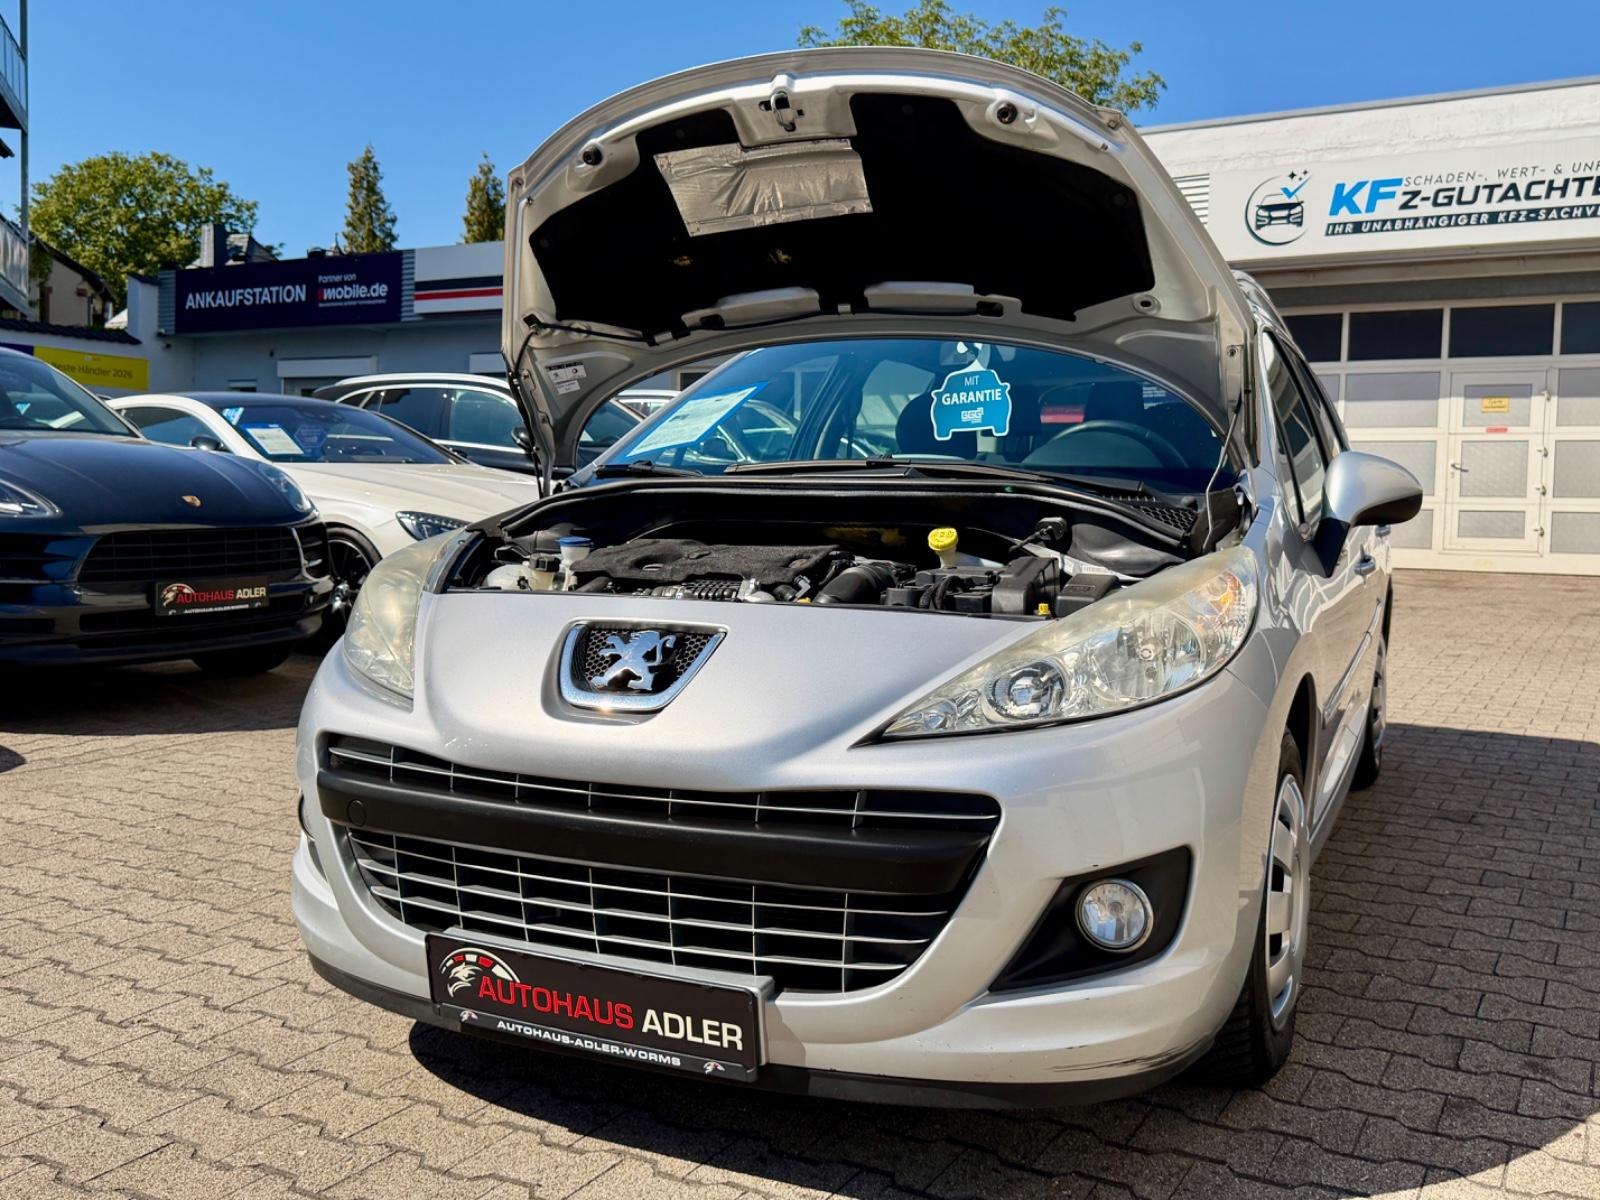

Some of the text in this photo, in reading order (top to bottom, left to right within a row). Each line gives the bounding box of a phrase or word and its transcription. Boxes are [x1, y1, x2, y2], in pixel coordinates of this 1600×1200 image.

[1497, 165, 1546, 179] WERT-
[1553, 163, 1563, 175] &
[1328, 223, 1354, 235] IHR
[1361, 213, 1489, 232] UNABHÄNGIGER
[185, 284, 307, 310] ANKAUFSTATION
[323, 283, 388, 300] mobile.de
[78, 364, 111, 377] Händler
[964, 375, 980, 387] MIT
[942, 388, 1002, 405] GARANTIE
[176, 587, 266, 604] AUTOHAUS ADLER
[478, 975, 744, 1051] AUTOHAUS ADLER
[496, 1019, 682, 1067] AUTOHAUS-ADLER-WORMS
